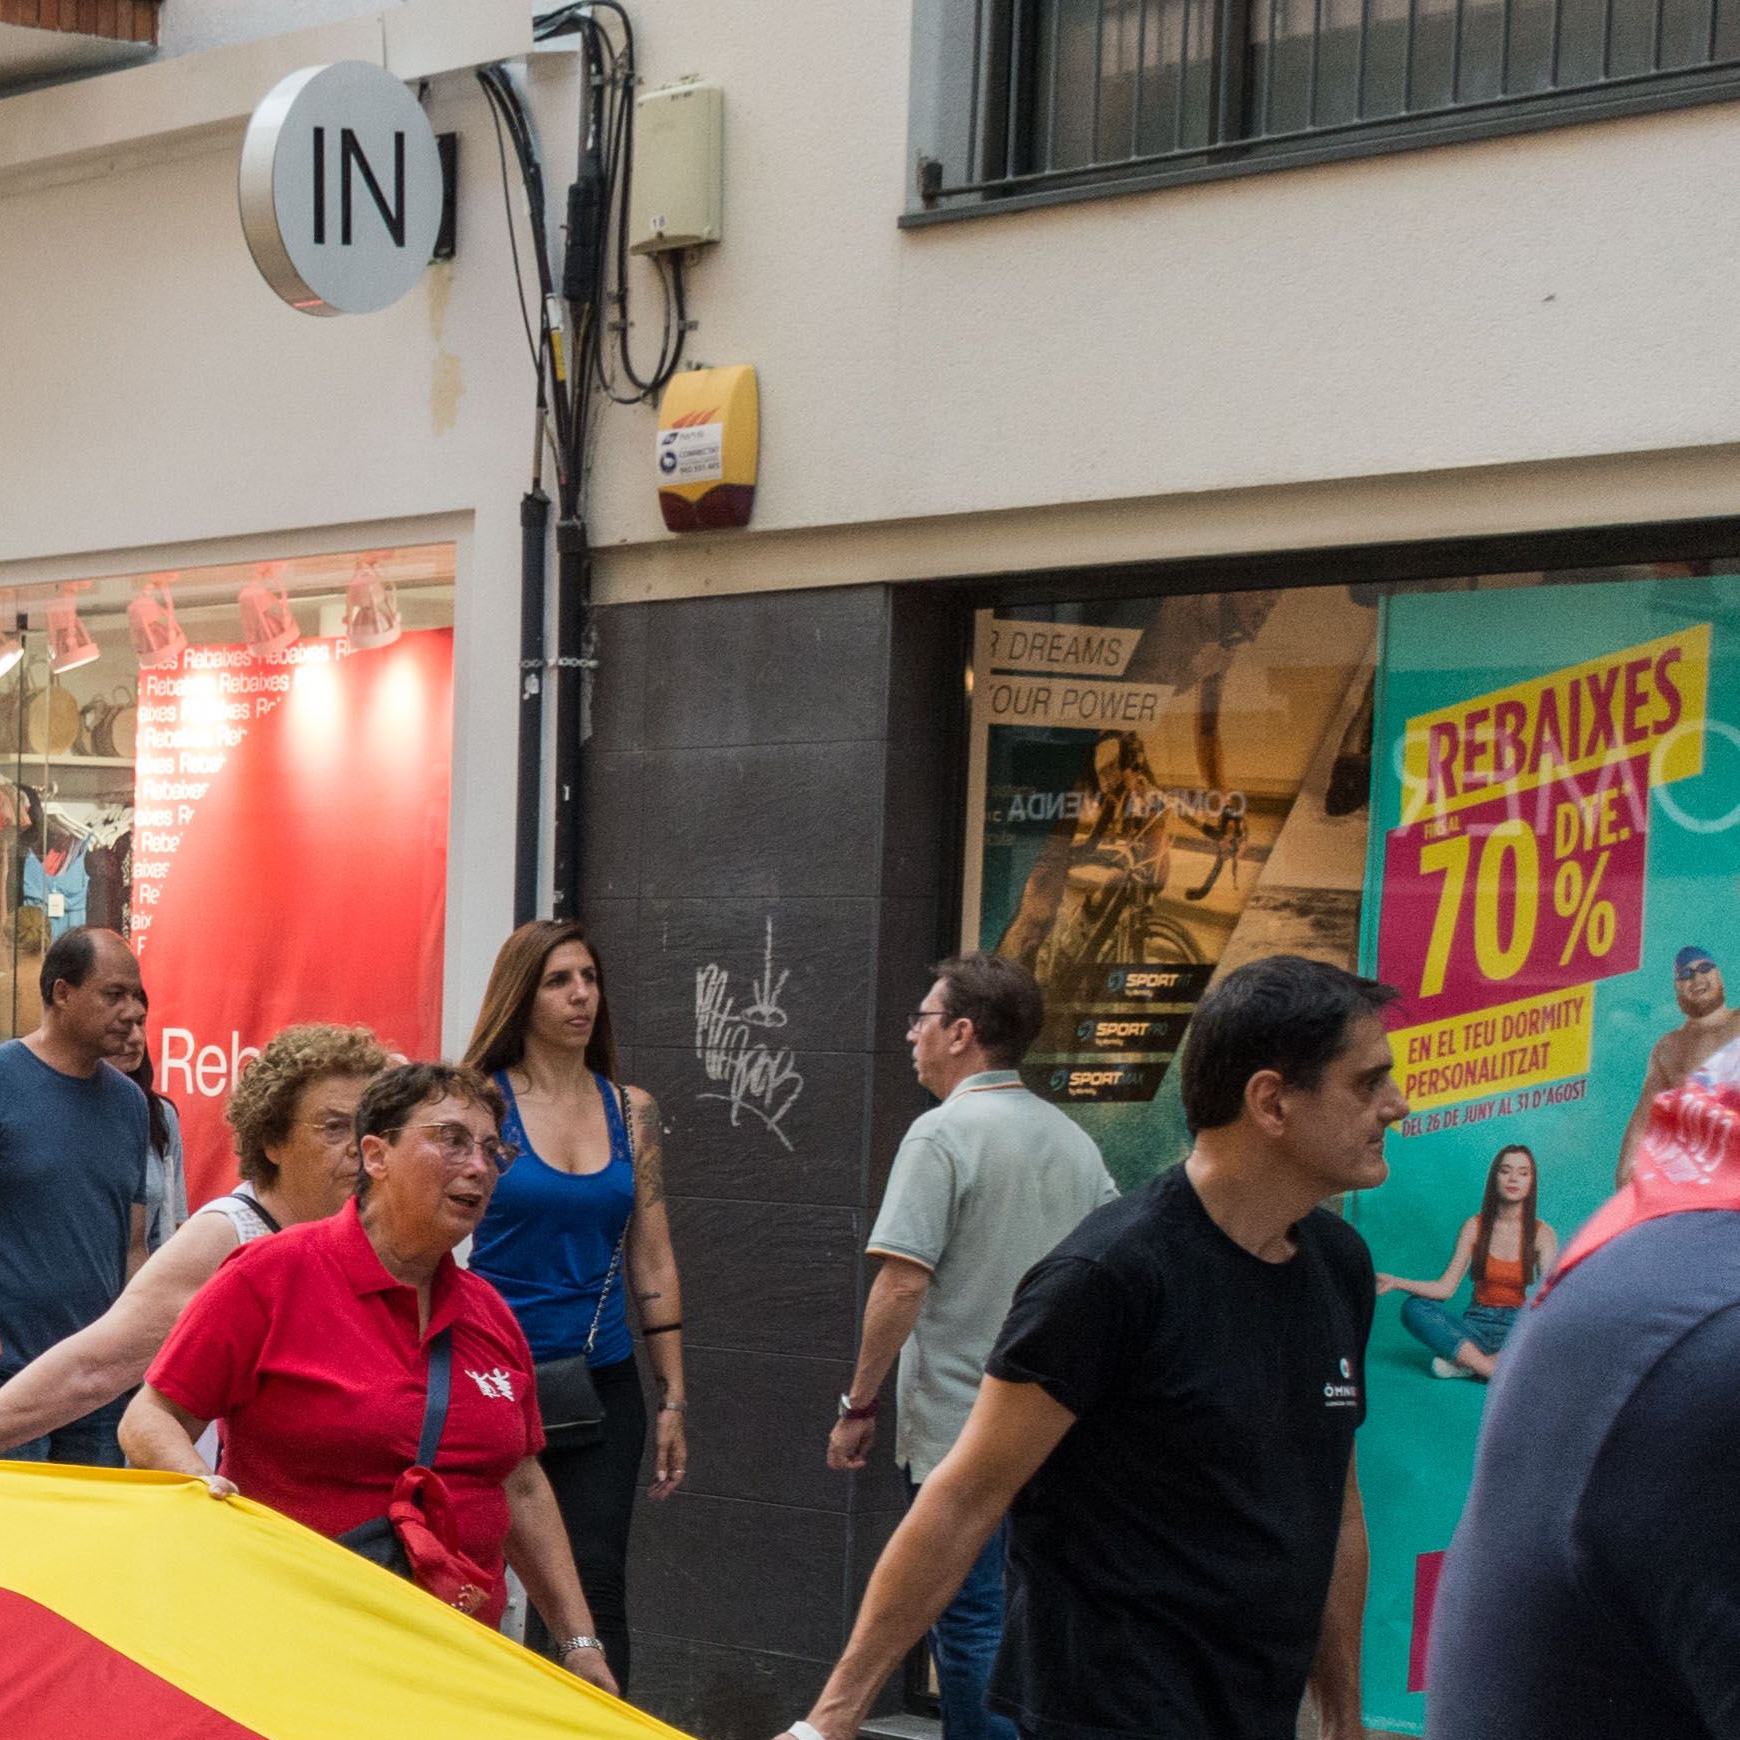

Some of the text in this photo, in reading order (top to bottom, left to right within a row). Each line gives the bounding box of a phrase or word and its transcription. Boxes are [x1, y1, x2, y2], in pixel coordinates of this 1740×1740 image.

[312, 126, 406, 248] IN
[1009, 631, 1124, 667] DREAMS
[989, 684, 1159, 722] OUR POWER
[1425, 647, 1683, 805] REBAIXES
[1408, 996, 1585, 1065] EN EL TEU DORMITY
[1405, 1041, 1551, 1101] PERSONALITZAT
[1401, 1119, 1423, 1138] DEL
[1443, 1107, 1459, 1128] DE
